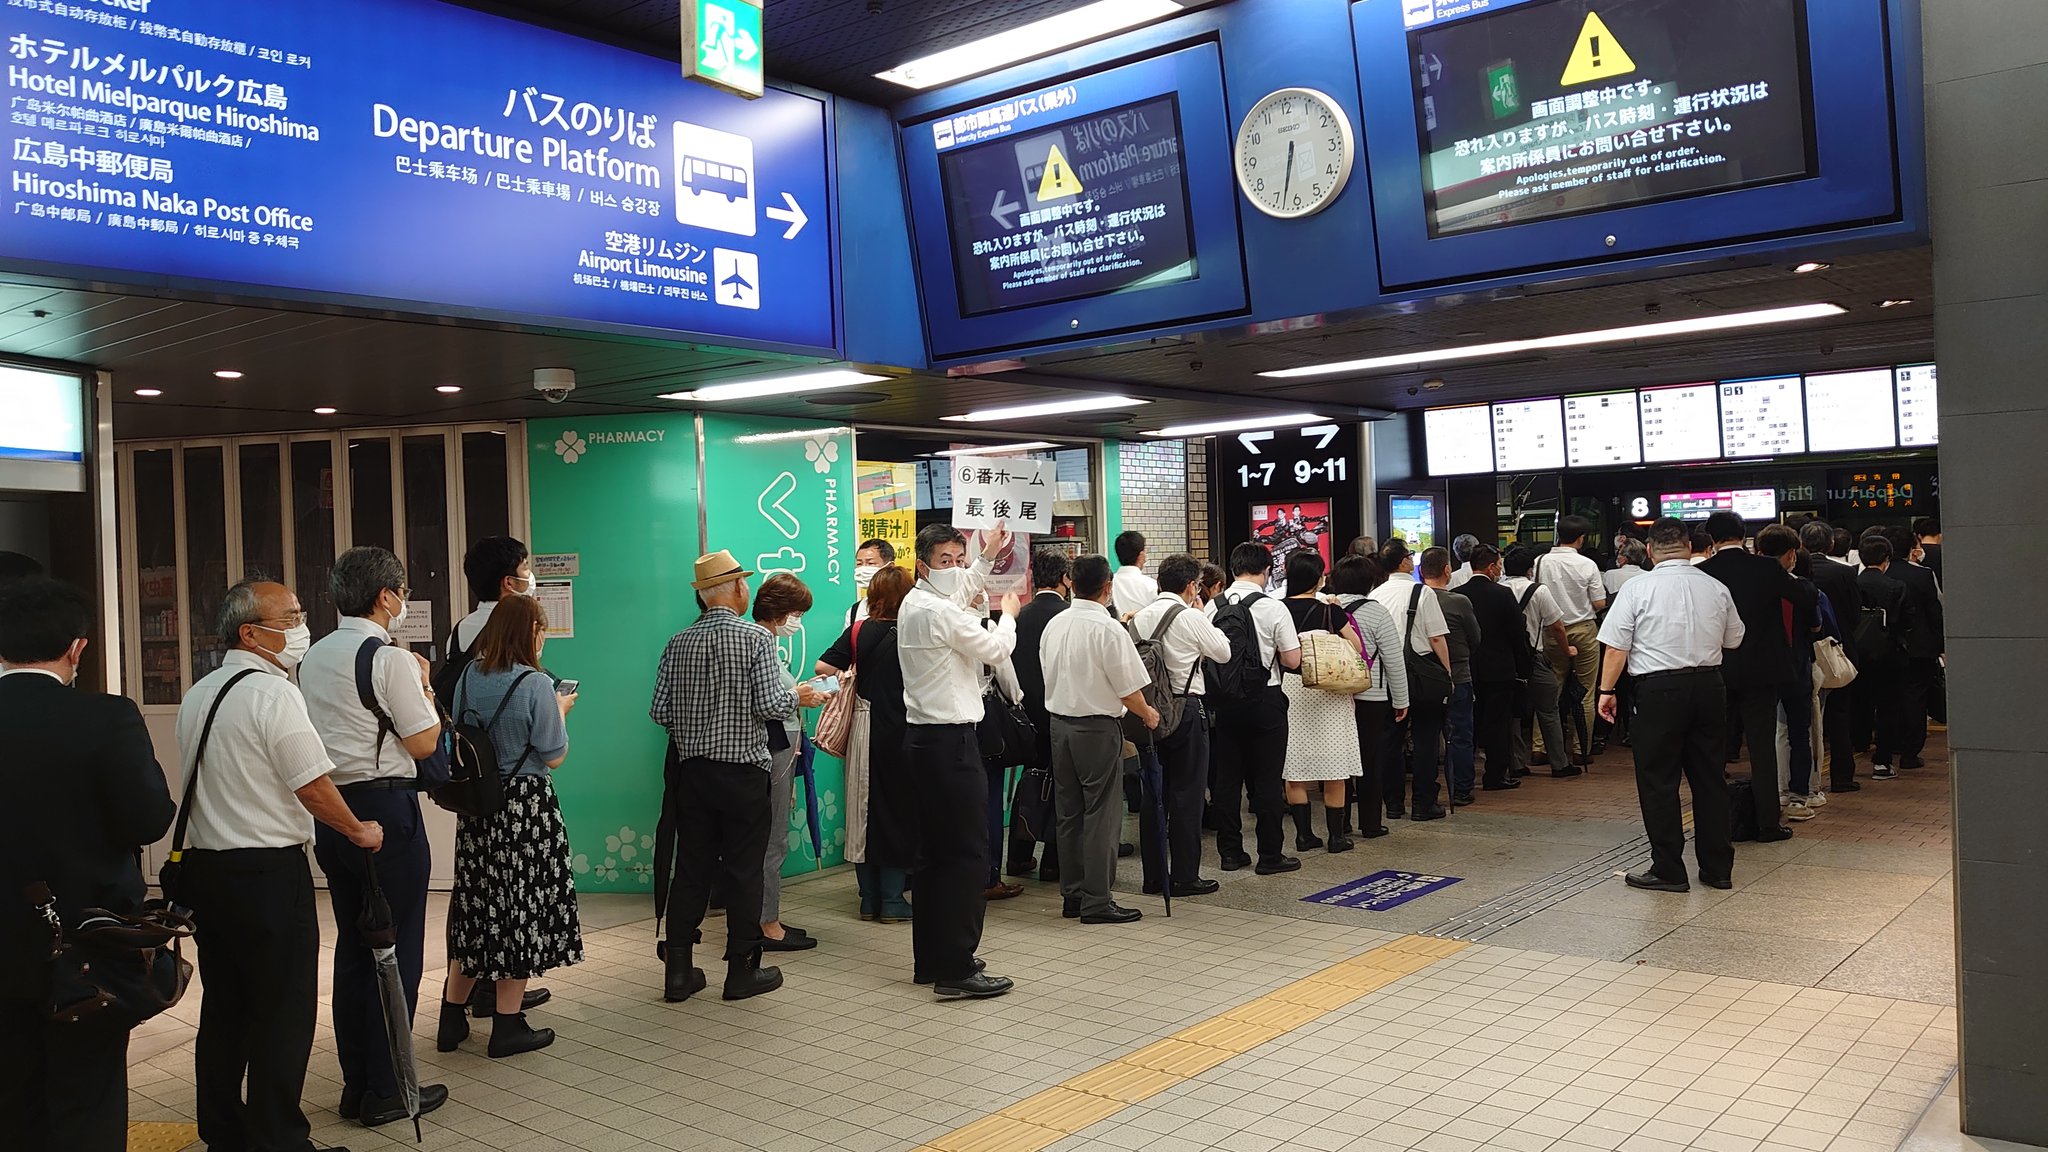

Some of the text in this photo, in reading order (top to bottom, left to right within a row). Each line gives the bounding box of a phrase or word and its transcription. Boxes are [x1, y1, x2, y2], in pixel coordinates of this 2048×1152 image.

[1437, 4, 1471, 18] Express
[1472, 0, 1489, 9] Bus
[286, 53, 311, 69] 로커
[9, 33, 288, 110] ホテルメルパルク広島
[9, 65, 320, 141] Hotel Mielparque Hiroshima
[1281, 101, 1292, 115] 12
[1531, 79, 1661, 119] 画面調整中です。
[502, 86, 658, 149] バスのりば
[1264, 113, 1272, 125] 11
[1320, 115, 1328, 128] 2
[1454, 81, 1768, 157] 恐れ入りますが、バス時刻・運行状況は
[977, 126, 1000, 139] Express
[999, 124, 1012, 134] Bus
[1251, 132, 1261, 145] 10
[373, 103, 661, 189] Departure Platform
[1328, 139, 1336, 152] 3
[1480, 117, 1731, 176] 案内所係員にお問い合せ下さい。
[1630, 154, 1647, 165] out
[1651, 151, 1662, 161] of
[1666, 146, 1700, 158] order.
[13, 137, 174, 184] 広島中郵便局
[1249, 157, 1257, 169] 9
[1326, 163, 1334, 175] 4
[395, 155, 478, 185] 巴士乘车场
[590, 190, 618, 207] 버스
[621, 196, 661, 217] 승강장
[1257, 178, 1265, 191] 8
[1499, 155, 1726, 199] Please ask member of staff for clarification.
[1273, 192, 1280, 204] 7
[1293, 193, 1302, 206] 6
[1312, 183, 1321, 196] 5
[12, 170, 313, 231] Hiroshima Naka Post Office
[1019, 199, 1100, 227] 画面調整中です。
[193, 224, 245, 243] 히로시마
[605, 231, 706, 263] 空港リムジン
[990, 229, 1145, 271] 案内所係員にお問い合せ下さい。
[578, 249, 708, 285] Airport Limousine
[1083, 258, 1093, 266] out
[1095, 255, 1103, 264] of
[1002, 259, 1142, 290] Please ask member of staff for clarification.
[690, 290, 709, 301] 버스
[588, 430, 665, 444] PHARMACY
[958, 465, 1045, 488] ⑥番ホーム
[1631, 497, 1649, 518] 8
[824, 478, 840, 585] PHARMACY
